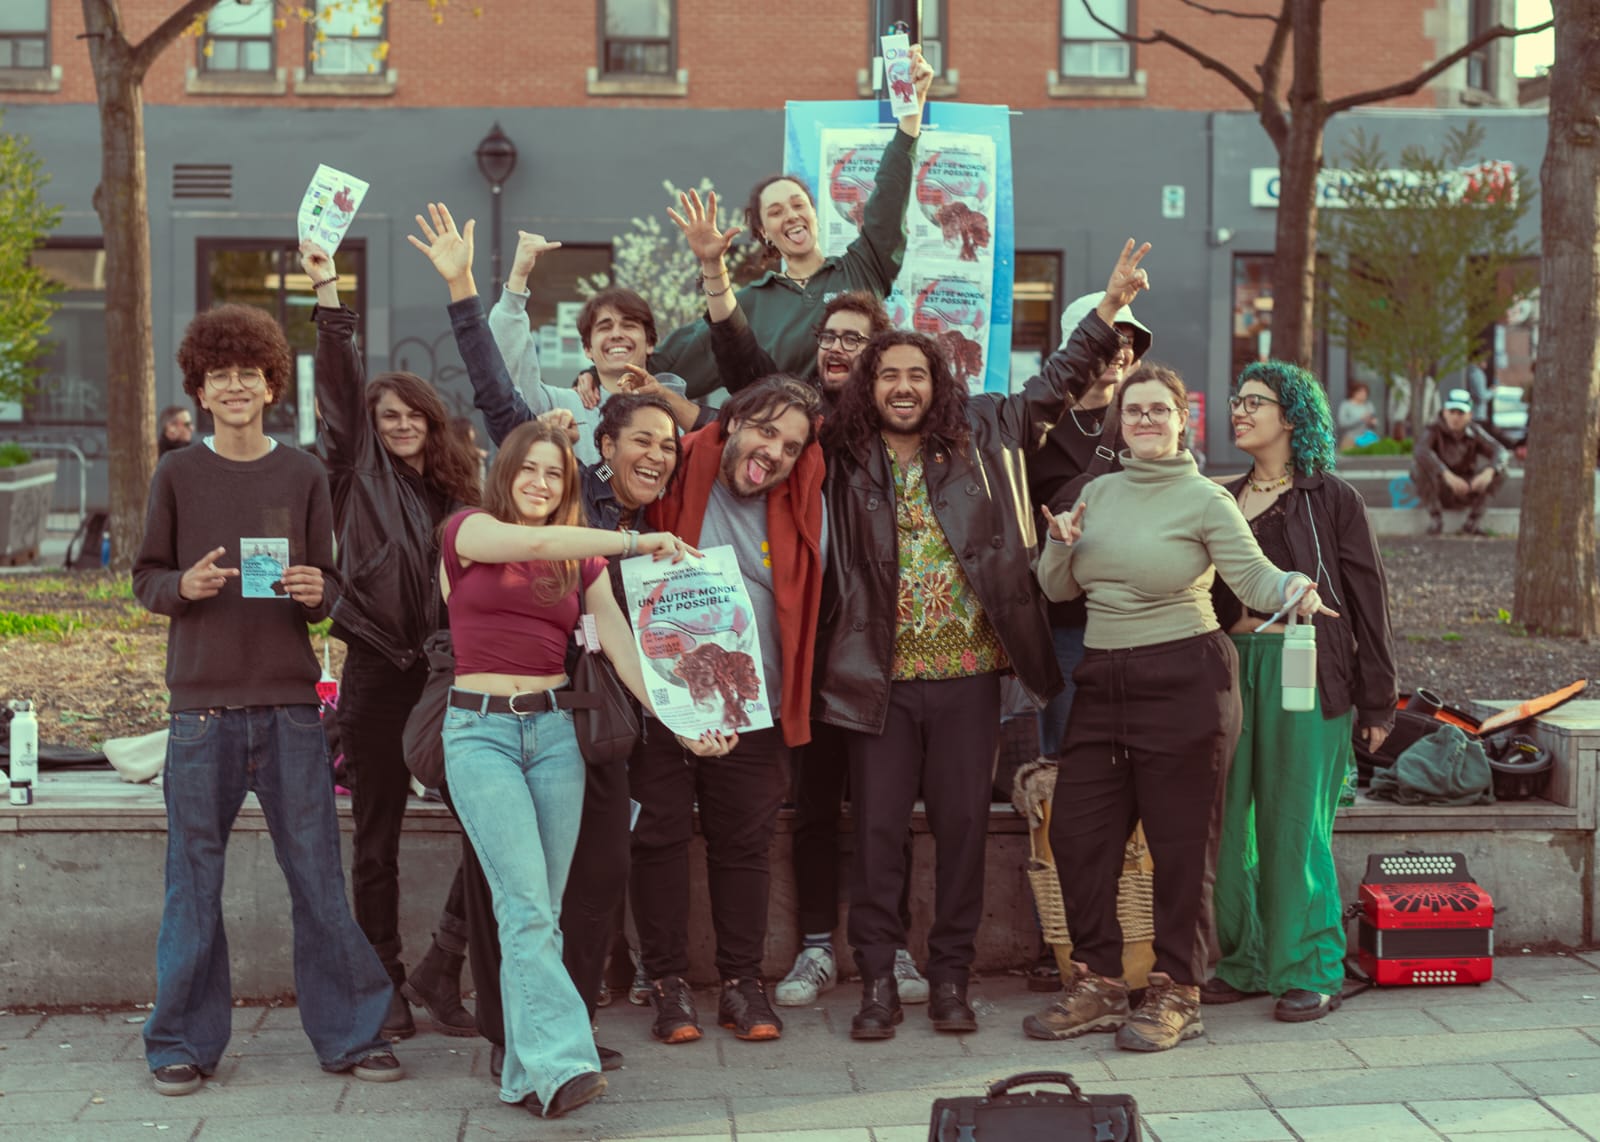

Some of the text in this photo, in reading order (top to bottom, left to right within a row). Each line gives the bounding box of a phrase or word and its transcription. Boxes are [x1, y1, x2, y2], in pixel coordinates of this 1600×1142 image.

[638, 584, 737, 608] UN AUTRE MONDE
[652, 595, 730, 616] EST POSSIBLE
